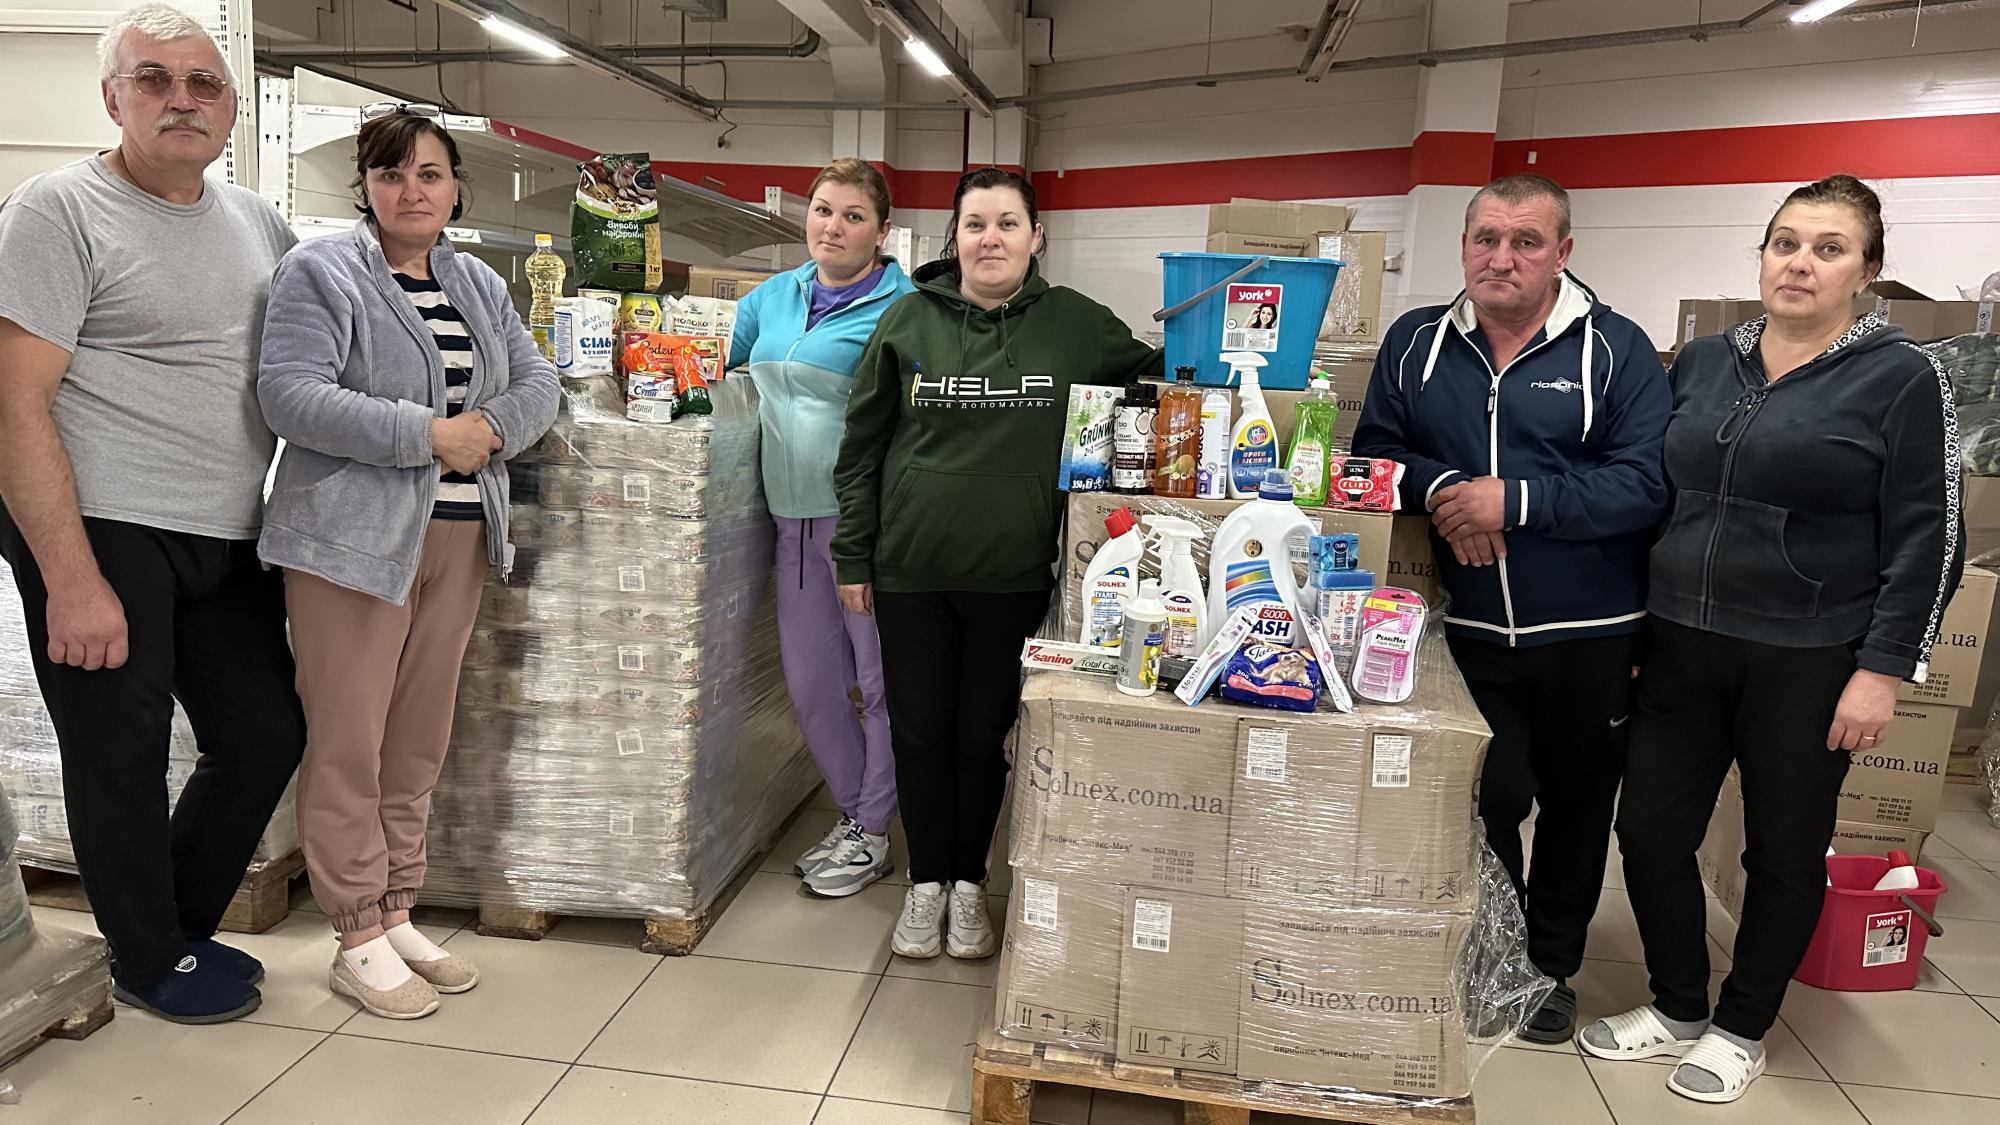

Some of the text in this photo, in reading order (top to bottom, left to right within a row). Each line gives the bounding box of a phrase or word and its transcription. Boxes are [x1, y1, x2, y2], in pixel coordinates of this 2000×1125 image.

[607, 220, 639, 231] Вироби
[602, 230, 644, 239] макаронні
[1238, 290, 1264, 301] york
[673, 317, 708, 327] МОЛОКО
[580, 337, 612, 348] СІЛЬ
[1079, 419, 1116, 448] GRÜNW
[1343, 481, 1369, 489] FLIRT
[1097, 580, 1126, 588] SOLNEX
[1032, 653, 1074, 665] sanino
[1080, 659, 1101, 668] Total
[1097, 716, 1112, 727] під
[1114, 718, 1157, 730] надійним
[1159, 723, 1201, 734] захистом
[1030, 746, 1224, 815] Solnex.com.ua
[1876, 917, 1897, 928] york
